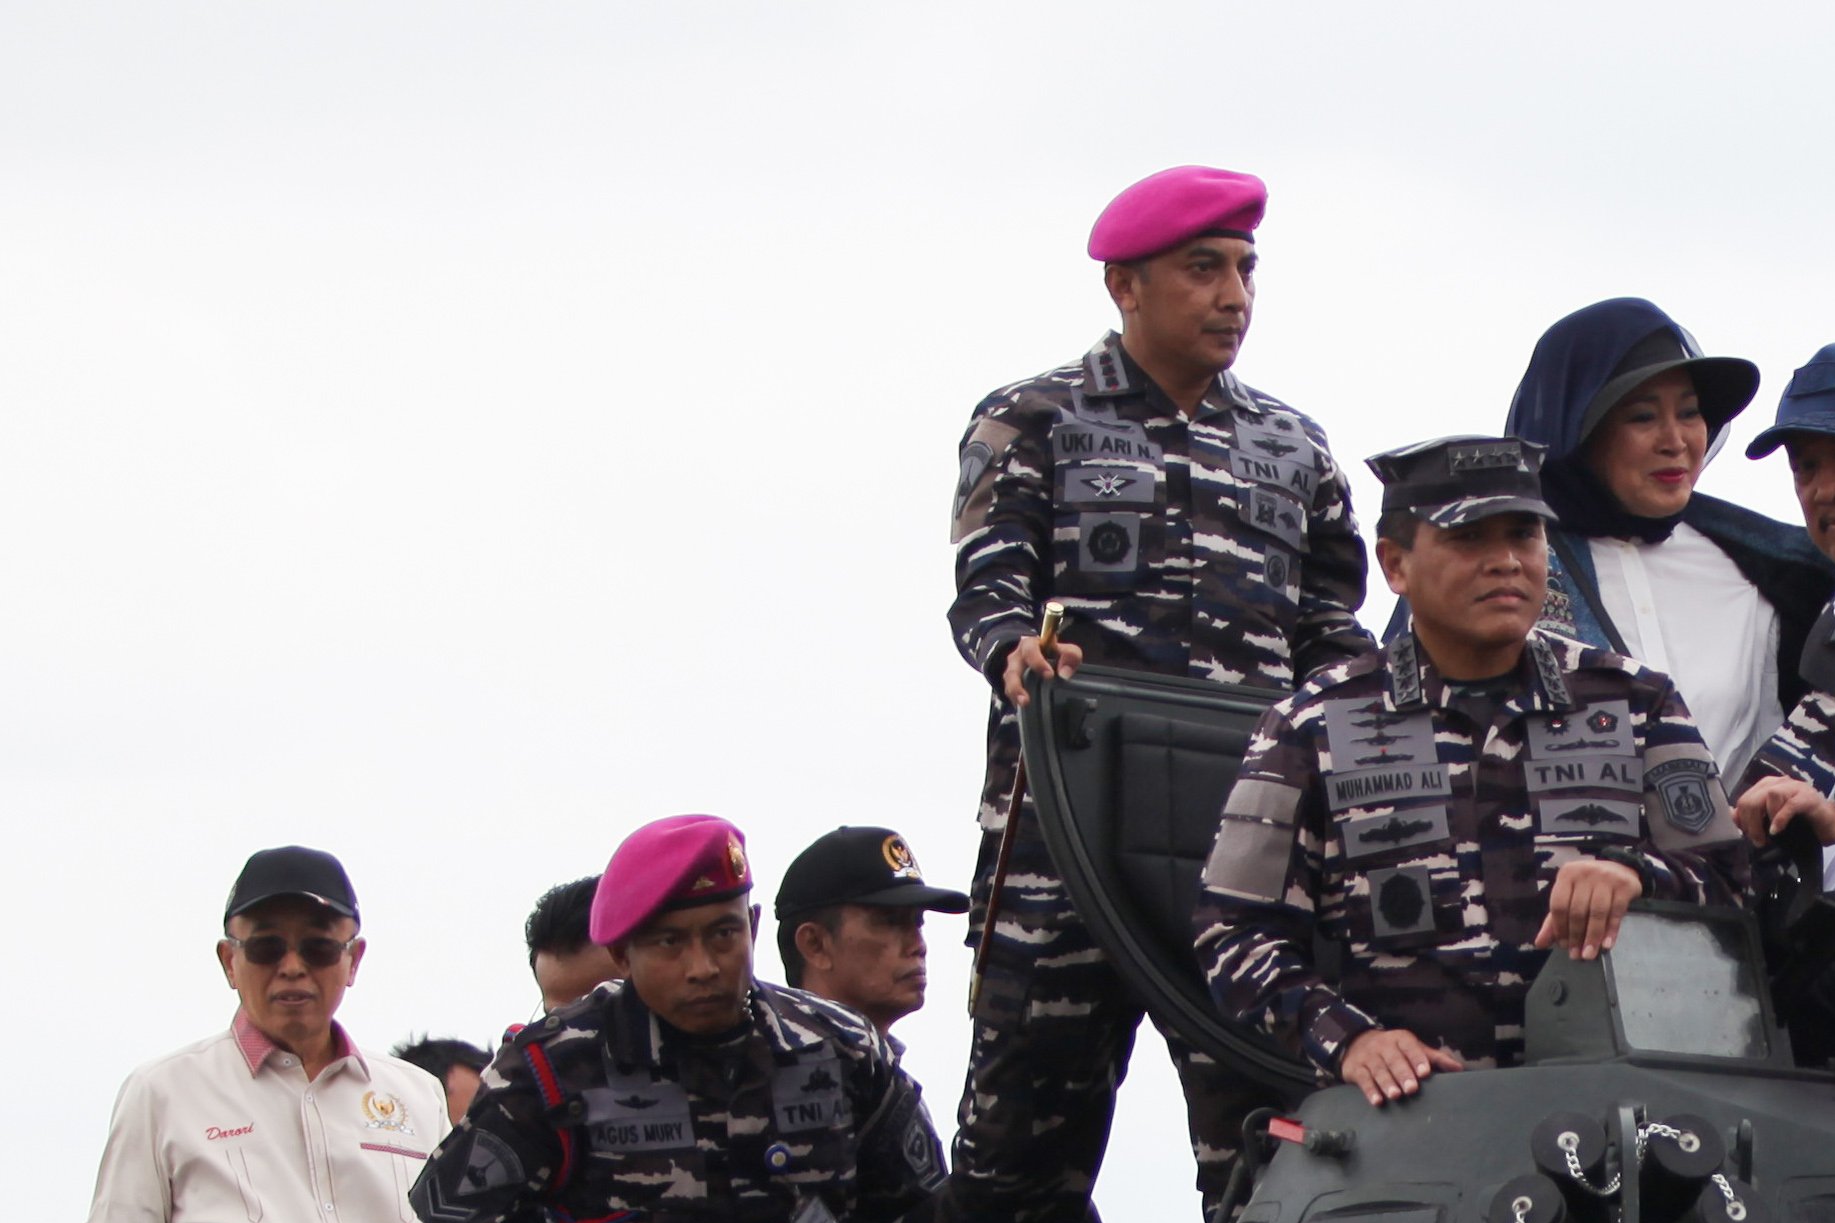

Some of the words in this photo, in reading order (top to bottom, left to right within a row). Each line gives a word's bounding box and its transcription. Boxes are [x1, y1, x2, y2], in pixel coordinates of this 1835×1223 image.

[1061, 433, 1093, 453] UKI
[1100, 438, 1132, 457] ARI
[1138, 444, 1155, 459] N.
[1240, 459, 1279, 480] TNI
[1291, 470, 1311, 494] AL
[1336, 772, 1412, 800] MUHAMMAD
[1420, 769, 1442, 791] ALI
[1534, 763, 1586, 784] TNI
[1599, 765, 1636, 785] AL
[783, 1102, 822, 1124] TNI
[206, 1123, 255, 1140] Darori
[597, 1124, 639, 1145] AGUS
[643, 1122, 682, 1142] MURY
